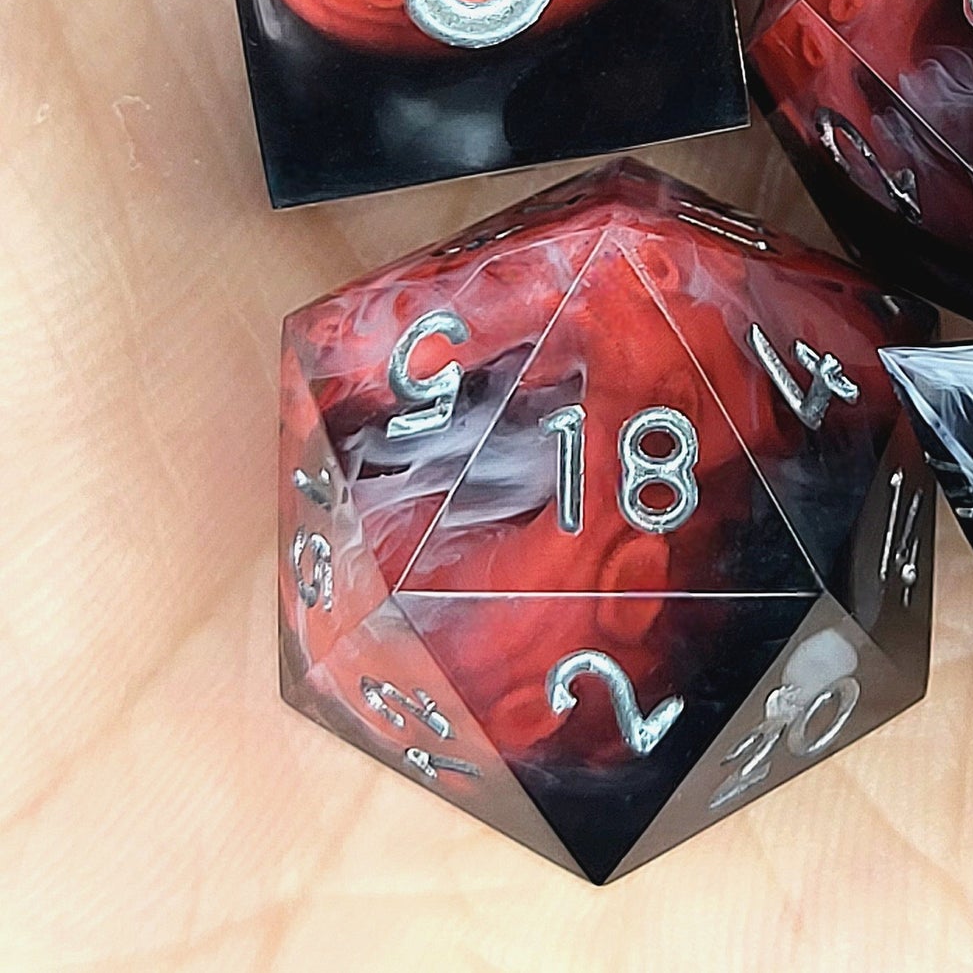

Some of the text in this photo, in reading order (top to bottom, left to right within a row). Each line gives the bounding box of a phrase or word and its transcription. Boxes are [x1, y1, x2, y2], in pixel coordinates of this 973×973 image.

[386, 309, 471, 439] 5
[751, 322, 860, 429] 4
[539, 403, 700, 534] 18
[546, 649, 685, 756] 2
